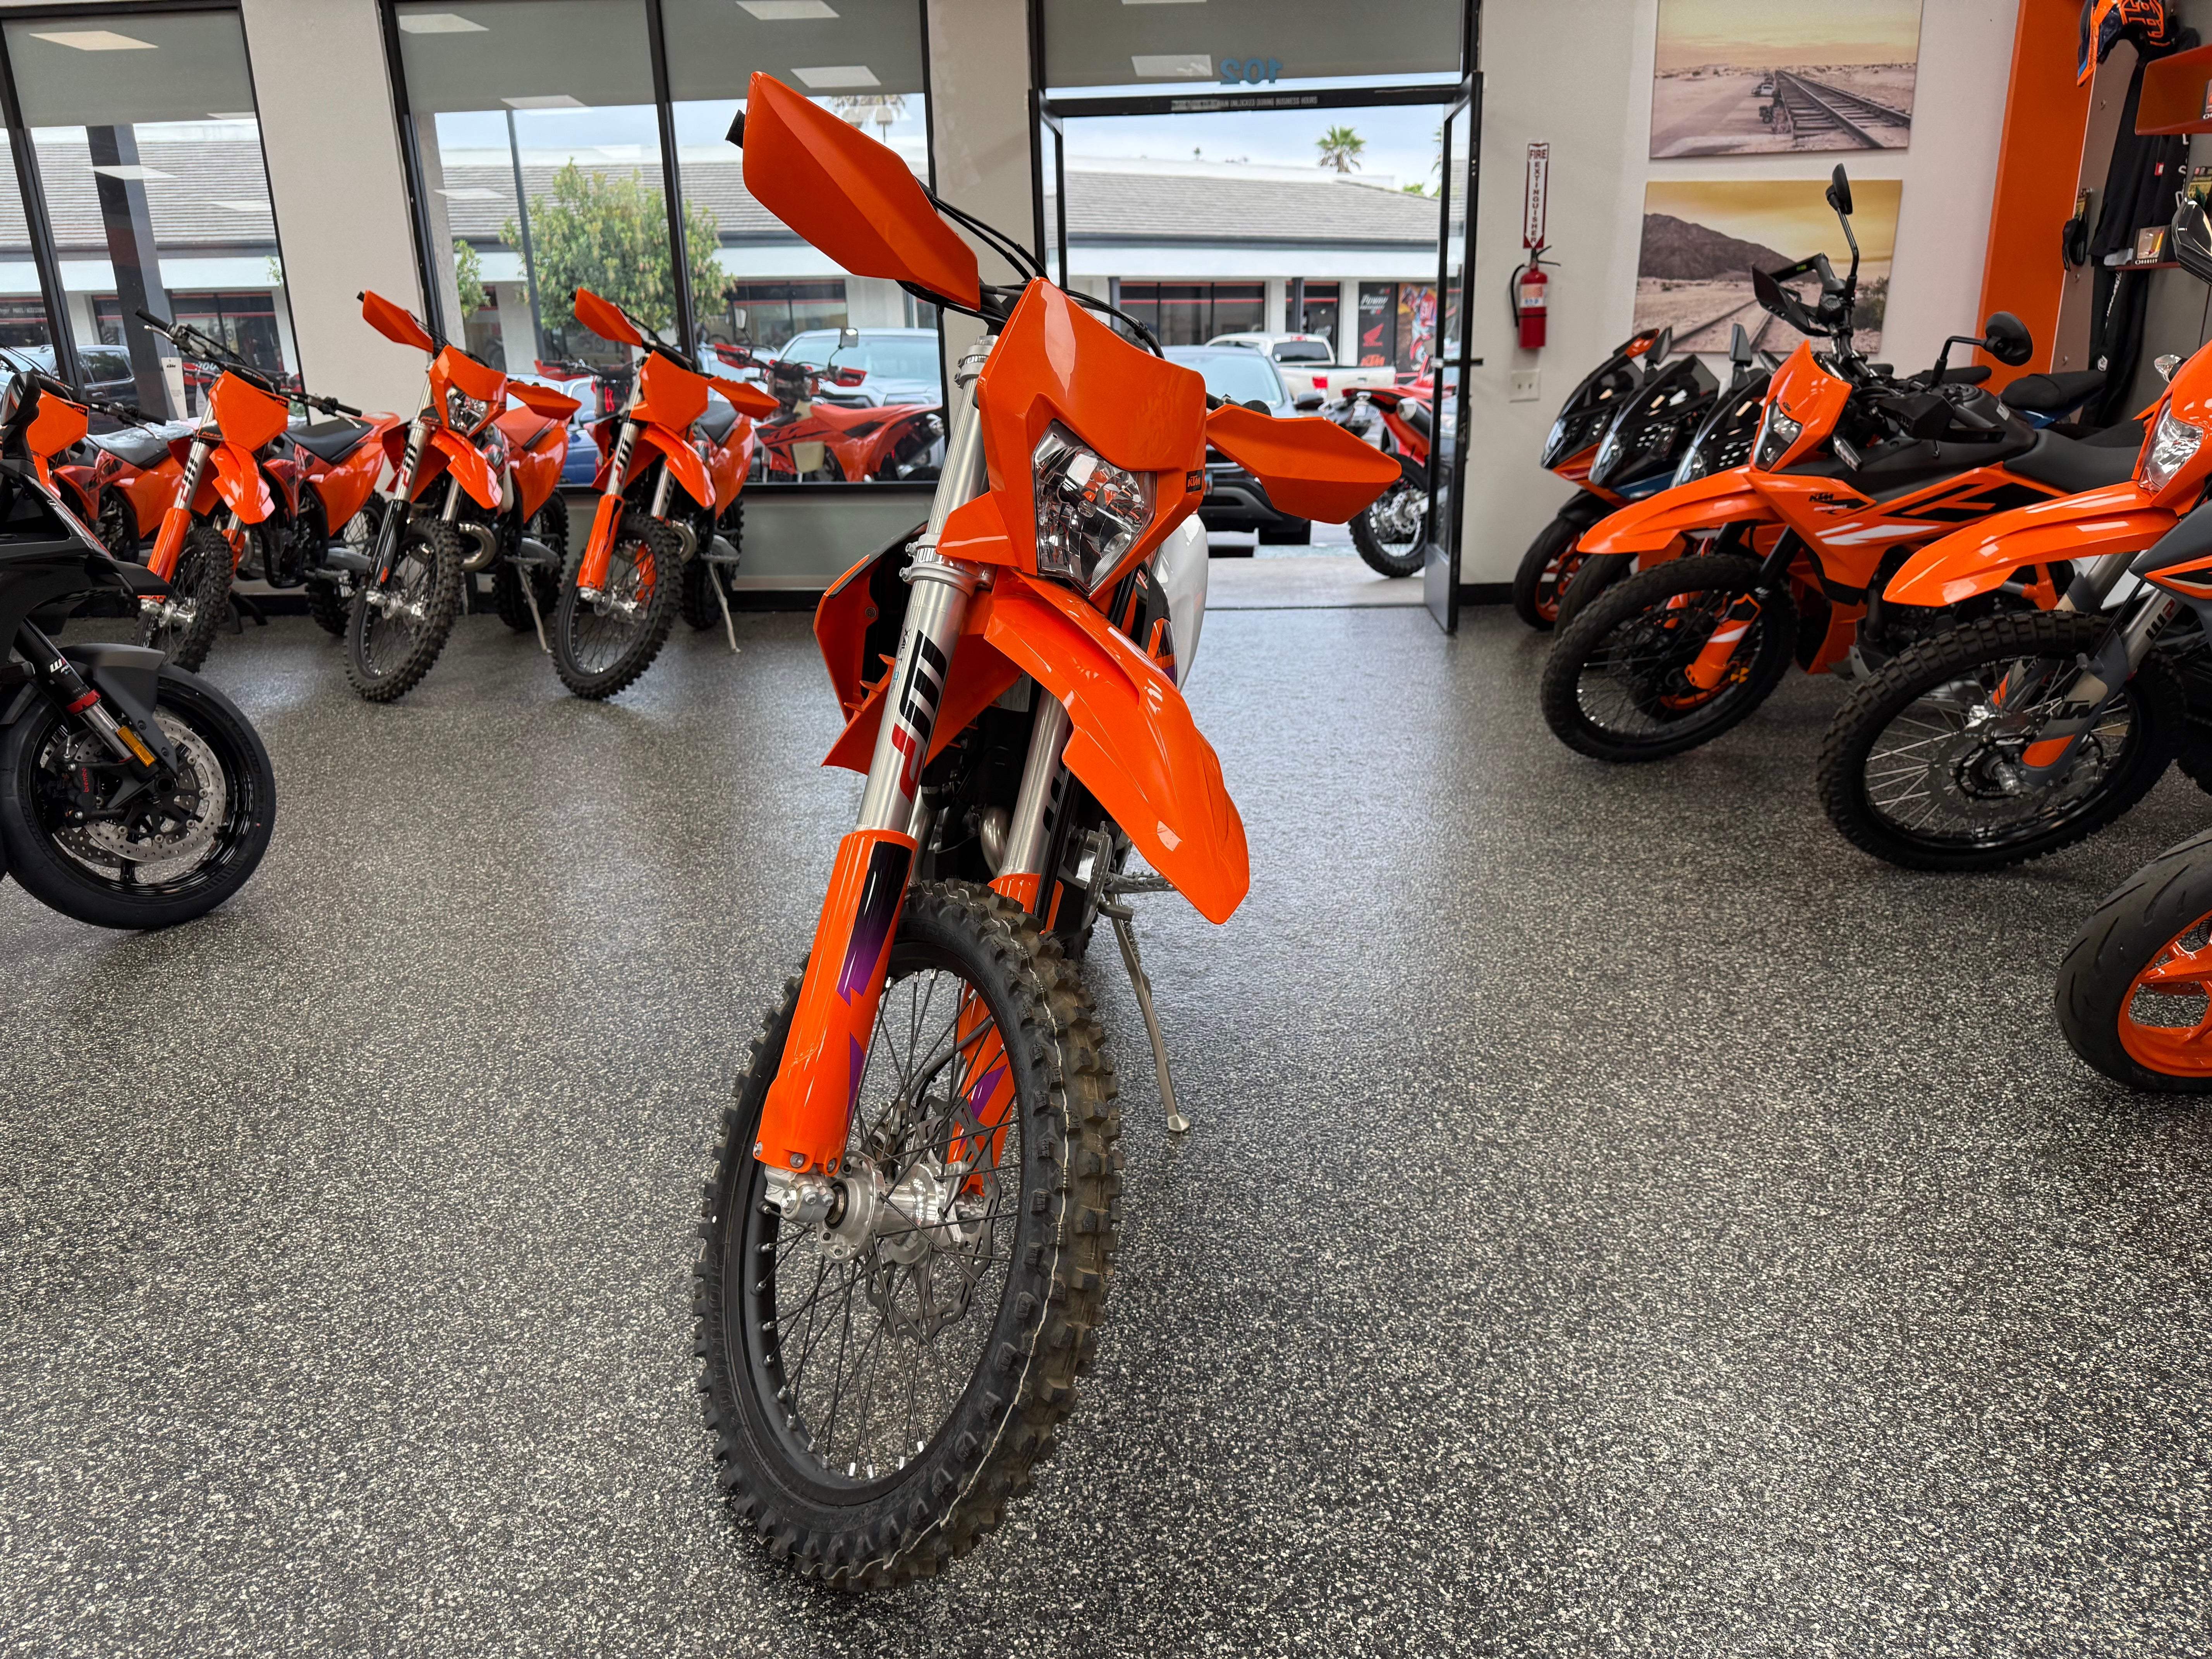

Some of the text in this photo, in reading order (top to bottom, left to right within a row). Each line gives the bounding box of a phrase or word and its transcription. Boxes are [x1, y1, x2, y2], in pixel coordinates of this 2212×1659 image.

[1530, 149, 1547, 159] FIRE
[1530, 161, 1540, 242] EXTINGUISHER
[1187, 476, 1201, 488] KTM
[2145, 598, 2175, 640] WP
[709, 1252, 734, 1413] DUNLOP
